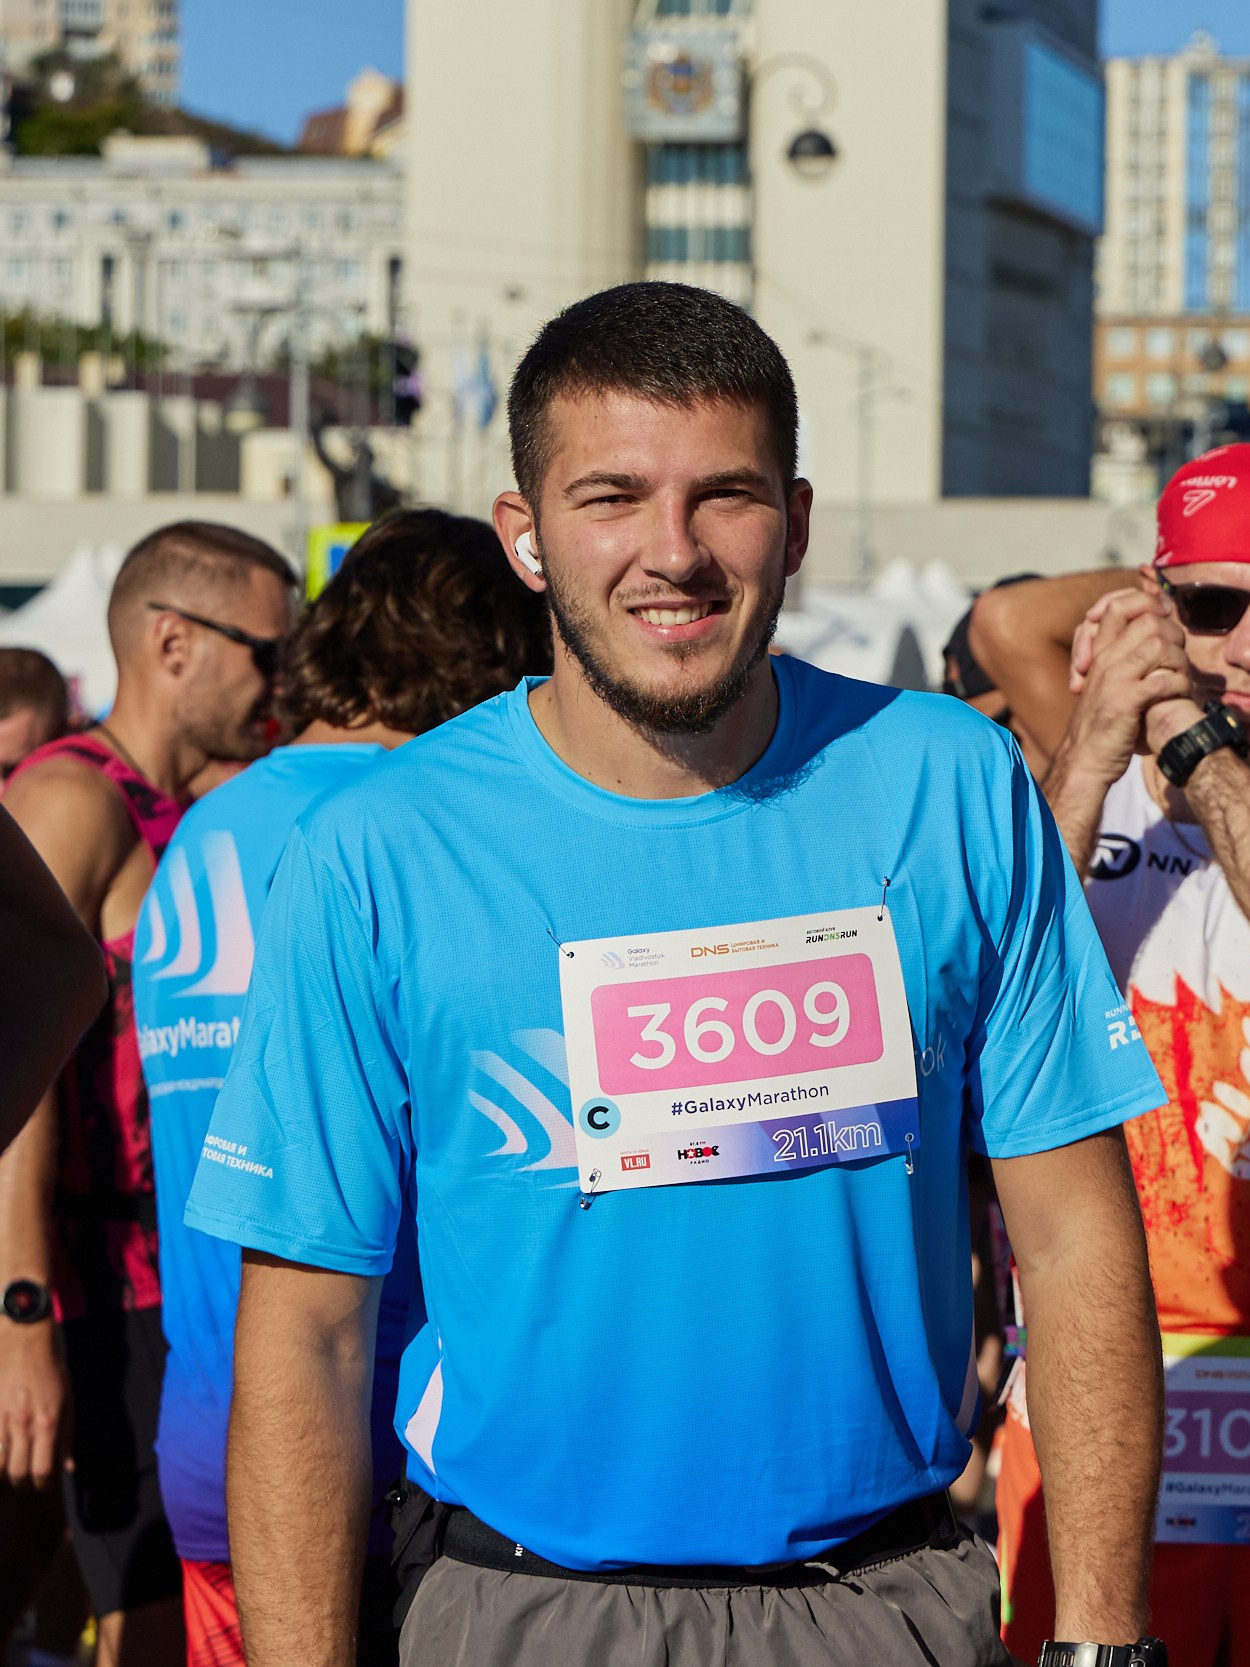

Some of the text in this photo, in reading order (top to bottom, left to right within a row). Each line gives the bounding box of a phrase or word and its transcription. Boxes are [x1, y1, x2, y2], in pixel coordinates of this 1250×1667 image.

[805, 929, 858, 944] RUNDNSRUN
[627, 947, 650, 955] Galaxy
[628, 952, 665, 962] Vladivostok
[690, 943, 730, 958] DNS
[628, 960, 659, 968] Marathon
[626, 981, 851, 1070] 3609
[671, 1082, 830, 1116] #GalaxyMarathon
[772, 1120, 882, 1163] 21.1km
[237, 1145, 248, 1156] И
[226, 1155, 274, 1179] ТЕХНИКА
[623, 1156, 647, 1169] VL.RU
